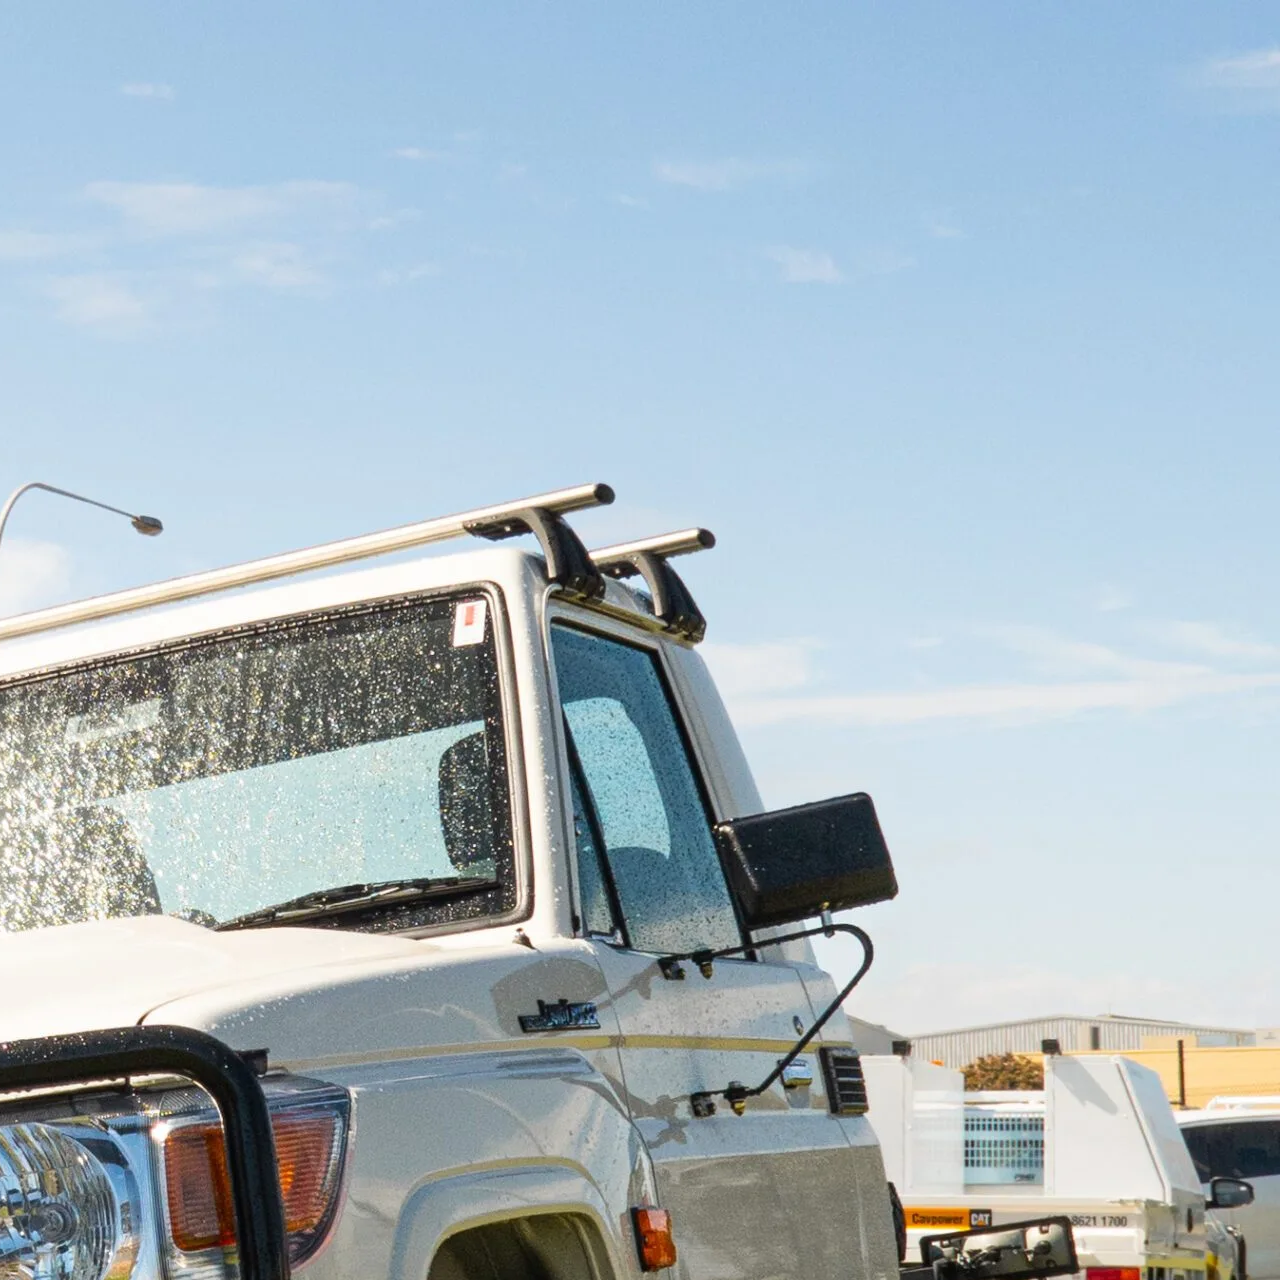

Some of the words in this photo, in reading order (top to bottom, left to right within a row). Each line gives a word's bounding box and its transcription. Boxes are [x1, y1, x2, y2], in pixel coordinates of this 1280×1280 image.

[912, 1213, 964, 1226] Cavpower
[970, 1212, 990, 1226] CAT
[1101, 1215, 1127, 1227] 1700
